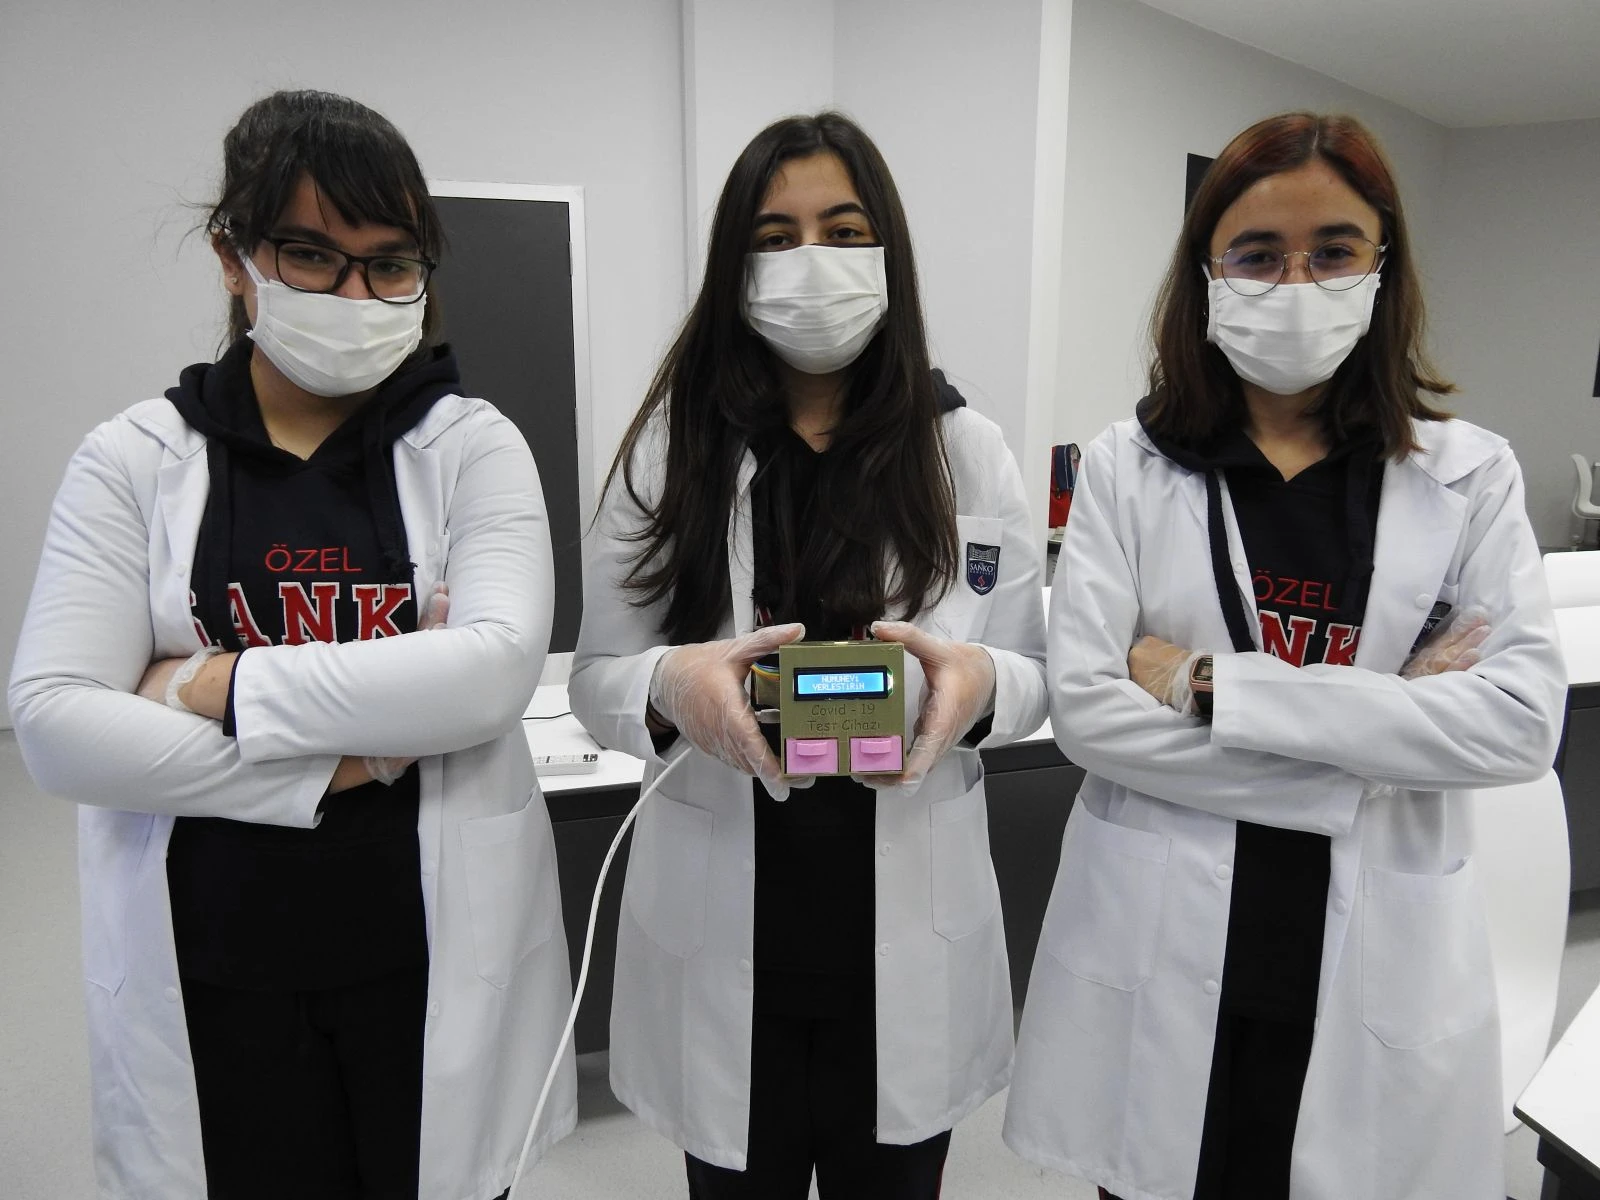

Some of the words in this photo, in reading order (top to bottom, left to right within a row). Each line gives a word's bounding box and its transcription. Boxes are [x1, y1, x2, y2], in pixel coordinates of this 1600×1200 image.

[265, 544, 362, 572] ÖZEL
[1253, 570, 1339, 610] ÖZEL
[811, 703, 846, 716] Covid
[862, 703, 875, 715] 19
[807, 720, 837, 731] Test
